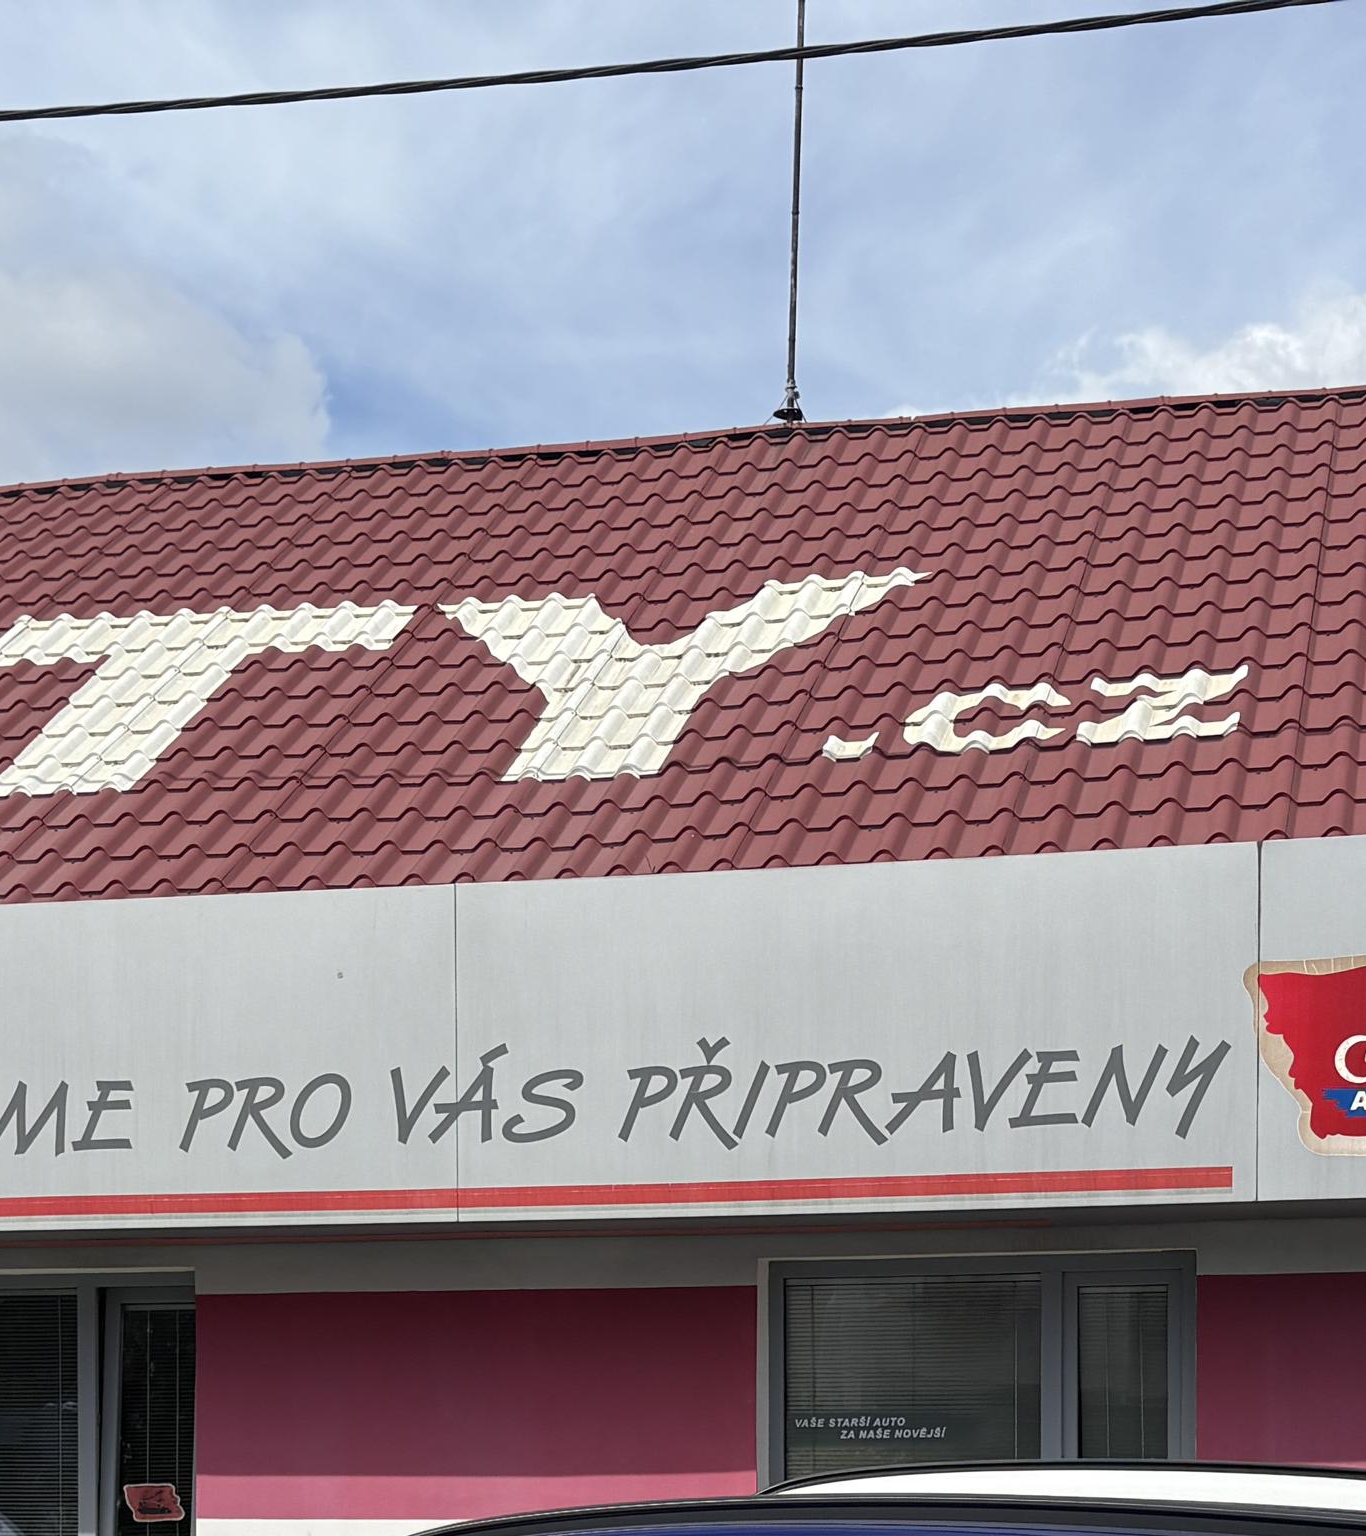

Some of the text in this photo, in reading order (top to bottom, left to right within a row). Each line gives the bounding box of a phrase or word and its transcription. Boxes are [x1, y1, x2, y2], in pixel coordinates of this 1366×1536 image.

[179, 1073, 352, 1160] PRO
[391, 1043, 584, 1145] VÁS
[618, 1035, 1232, 1151] PŘIPRAVENY
[795, 1416, 906, 1428] VAŠE STARŠÍ AUTO
[840, 1426, 946, 1439] ZA NAŠE NOVĚJŠÍ
